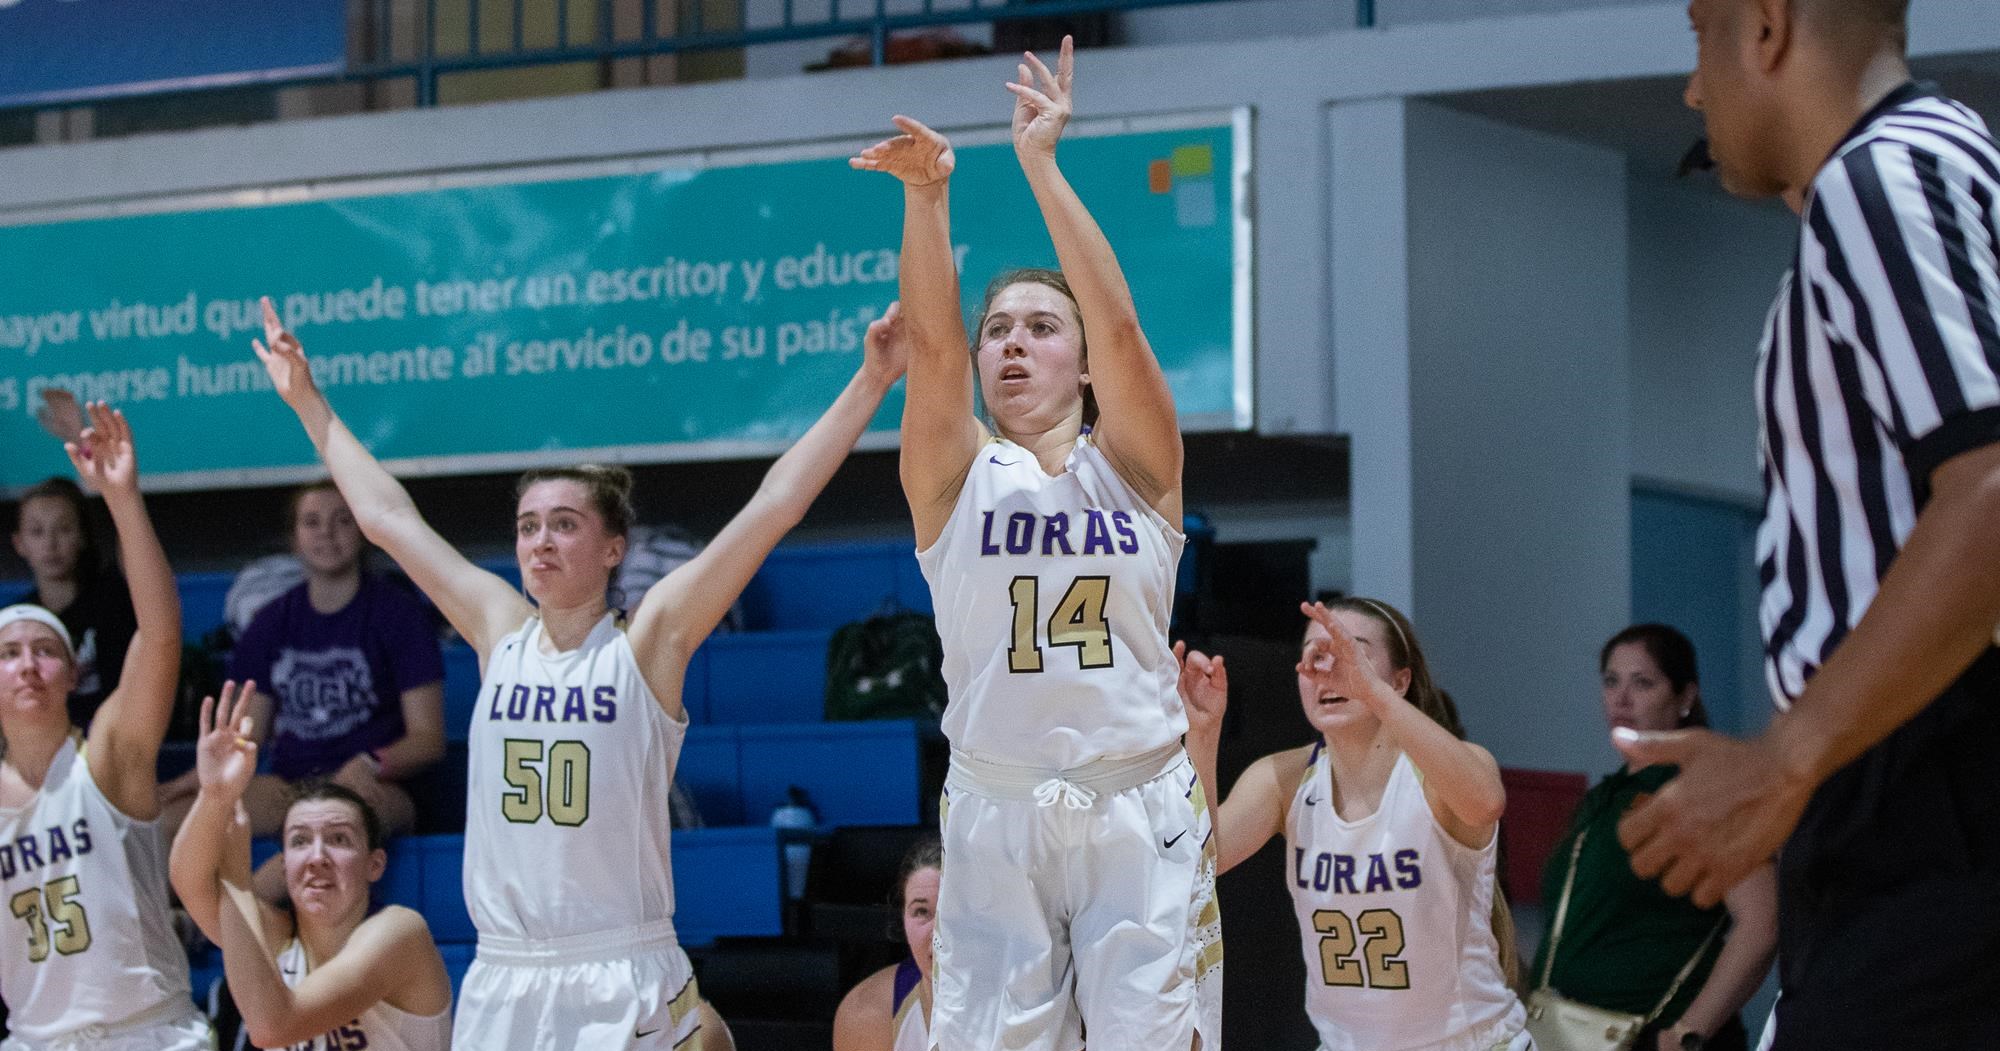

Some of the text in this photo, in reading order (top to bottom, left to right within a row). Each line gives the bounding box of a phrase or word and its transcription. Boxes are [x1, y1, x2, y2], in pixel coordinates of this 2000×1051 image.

[0, 310, 82, 356] ayor
[90, 292, 197, 339] virtud
[284, 277, 406, 332] puede
[416, 278, 517, 315] tener
[524, 270, 577, 308] un
[586, 256, 731, 302] escritor
[739, 257, 766, 300] y
[773, 240, 971, 290] educar
[176, 350, 456, 399] humemente
[462, 330, 497, 378] al
[505, 321, 654, 376] servicio
[660, 317, 710, 364] de
[720, 320, 766, 362] su
[980, 508, 1140, 556] LORAS
[1007, 575, 1114, 674] 14
[489, 683, 617, 723] LORAS
[502, 738, 591, 827] 50
[1295, 846, 1422, 895] LORAS
[9, 875, 93, 964] 35
[1312, 908, 1411, 990] 22
